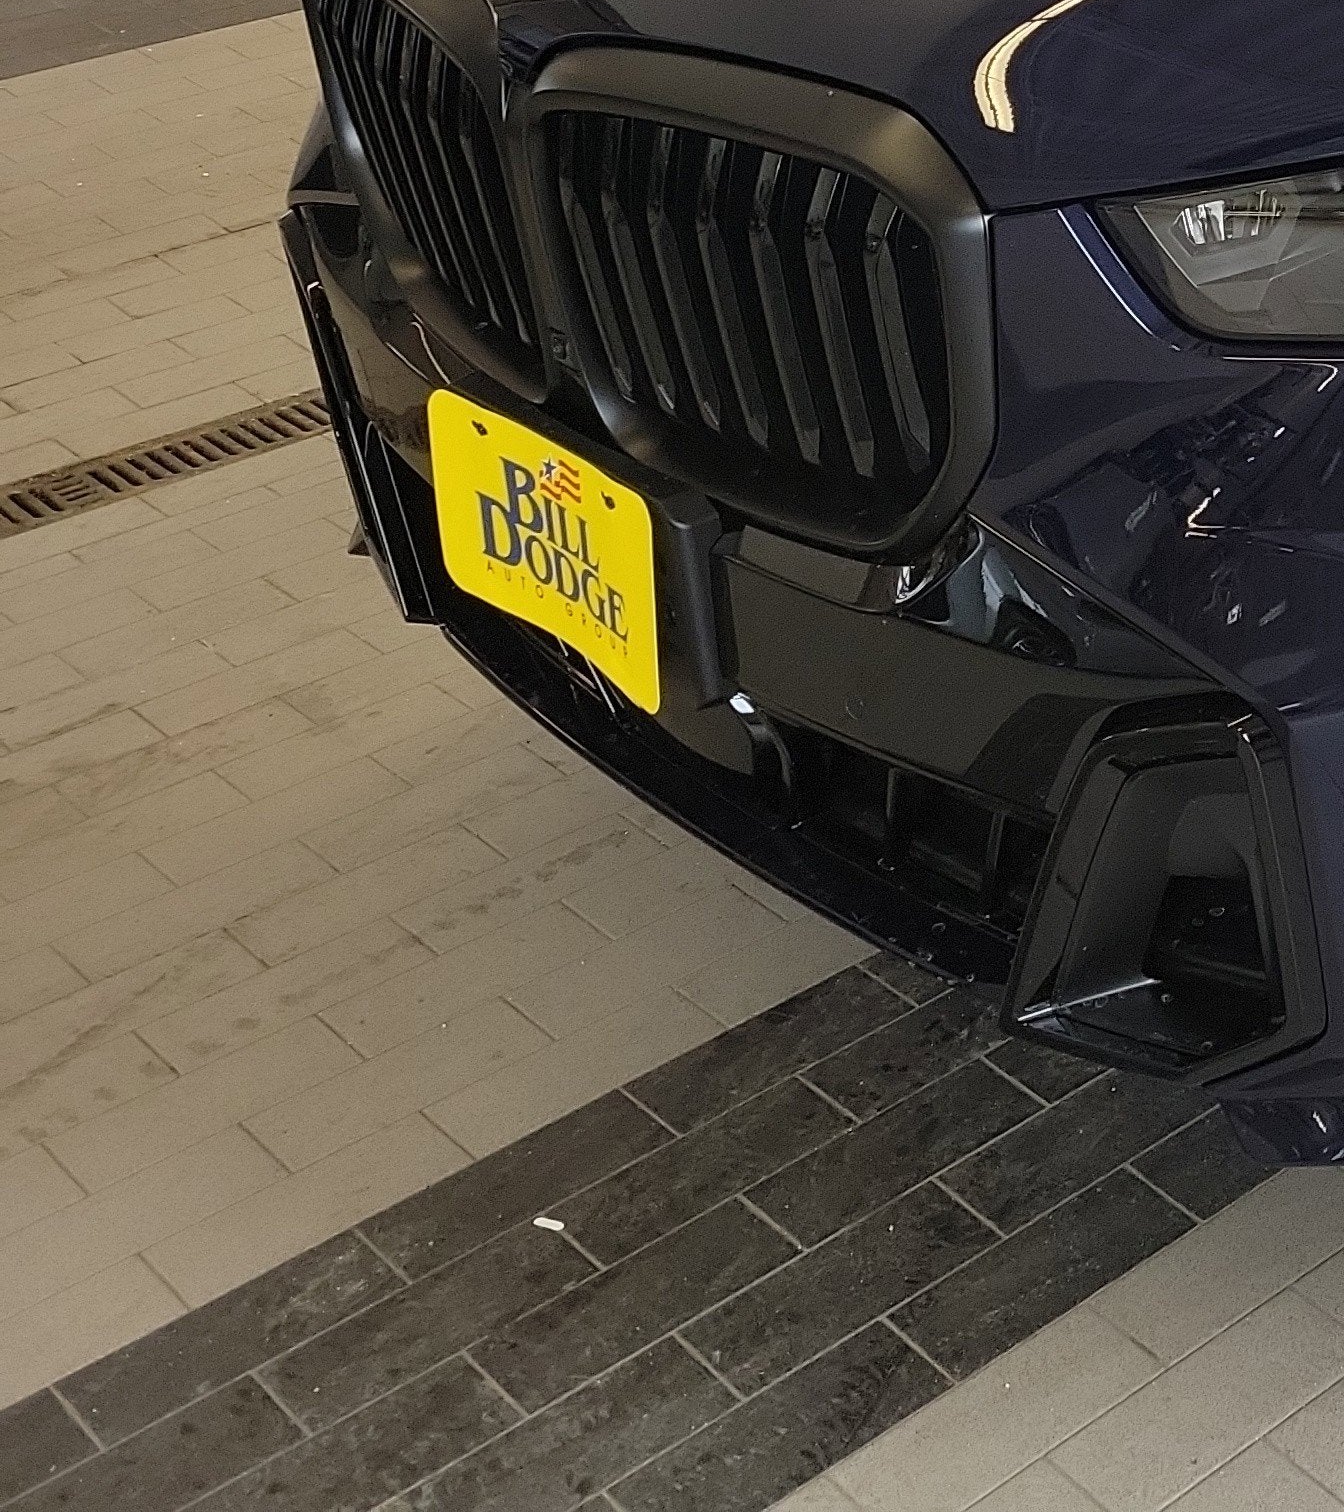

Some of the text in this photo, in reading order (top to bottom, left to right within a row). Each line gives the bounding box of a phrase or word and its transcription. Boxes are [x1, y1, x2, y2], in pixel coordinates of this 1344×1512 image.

[475, 489, 629, 641] DODGE
[499, 455, 600, 572] BILL
[485, 560, 629, 658] AUTO GROUP
